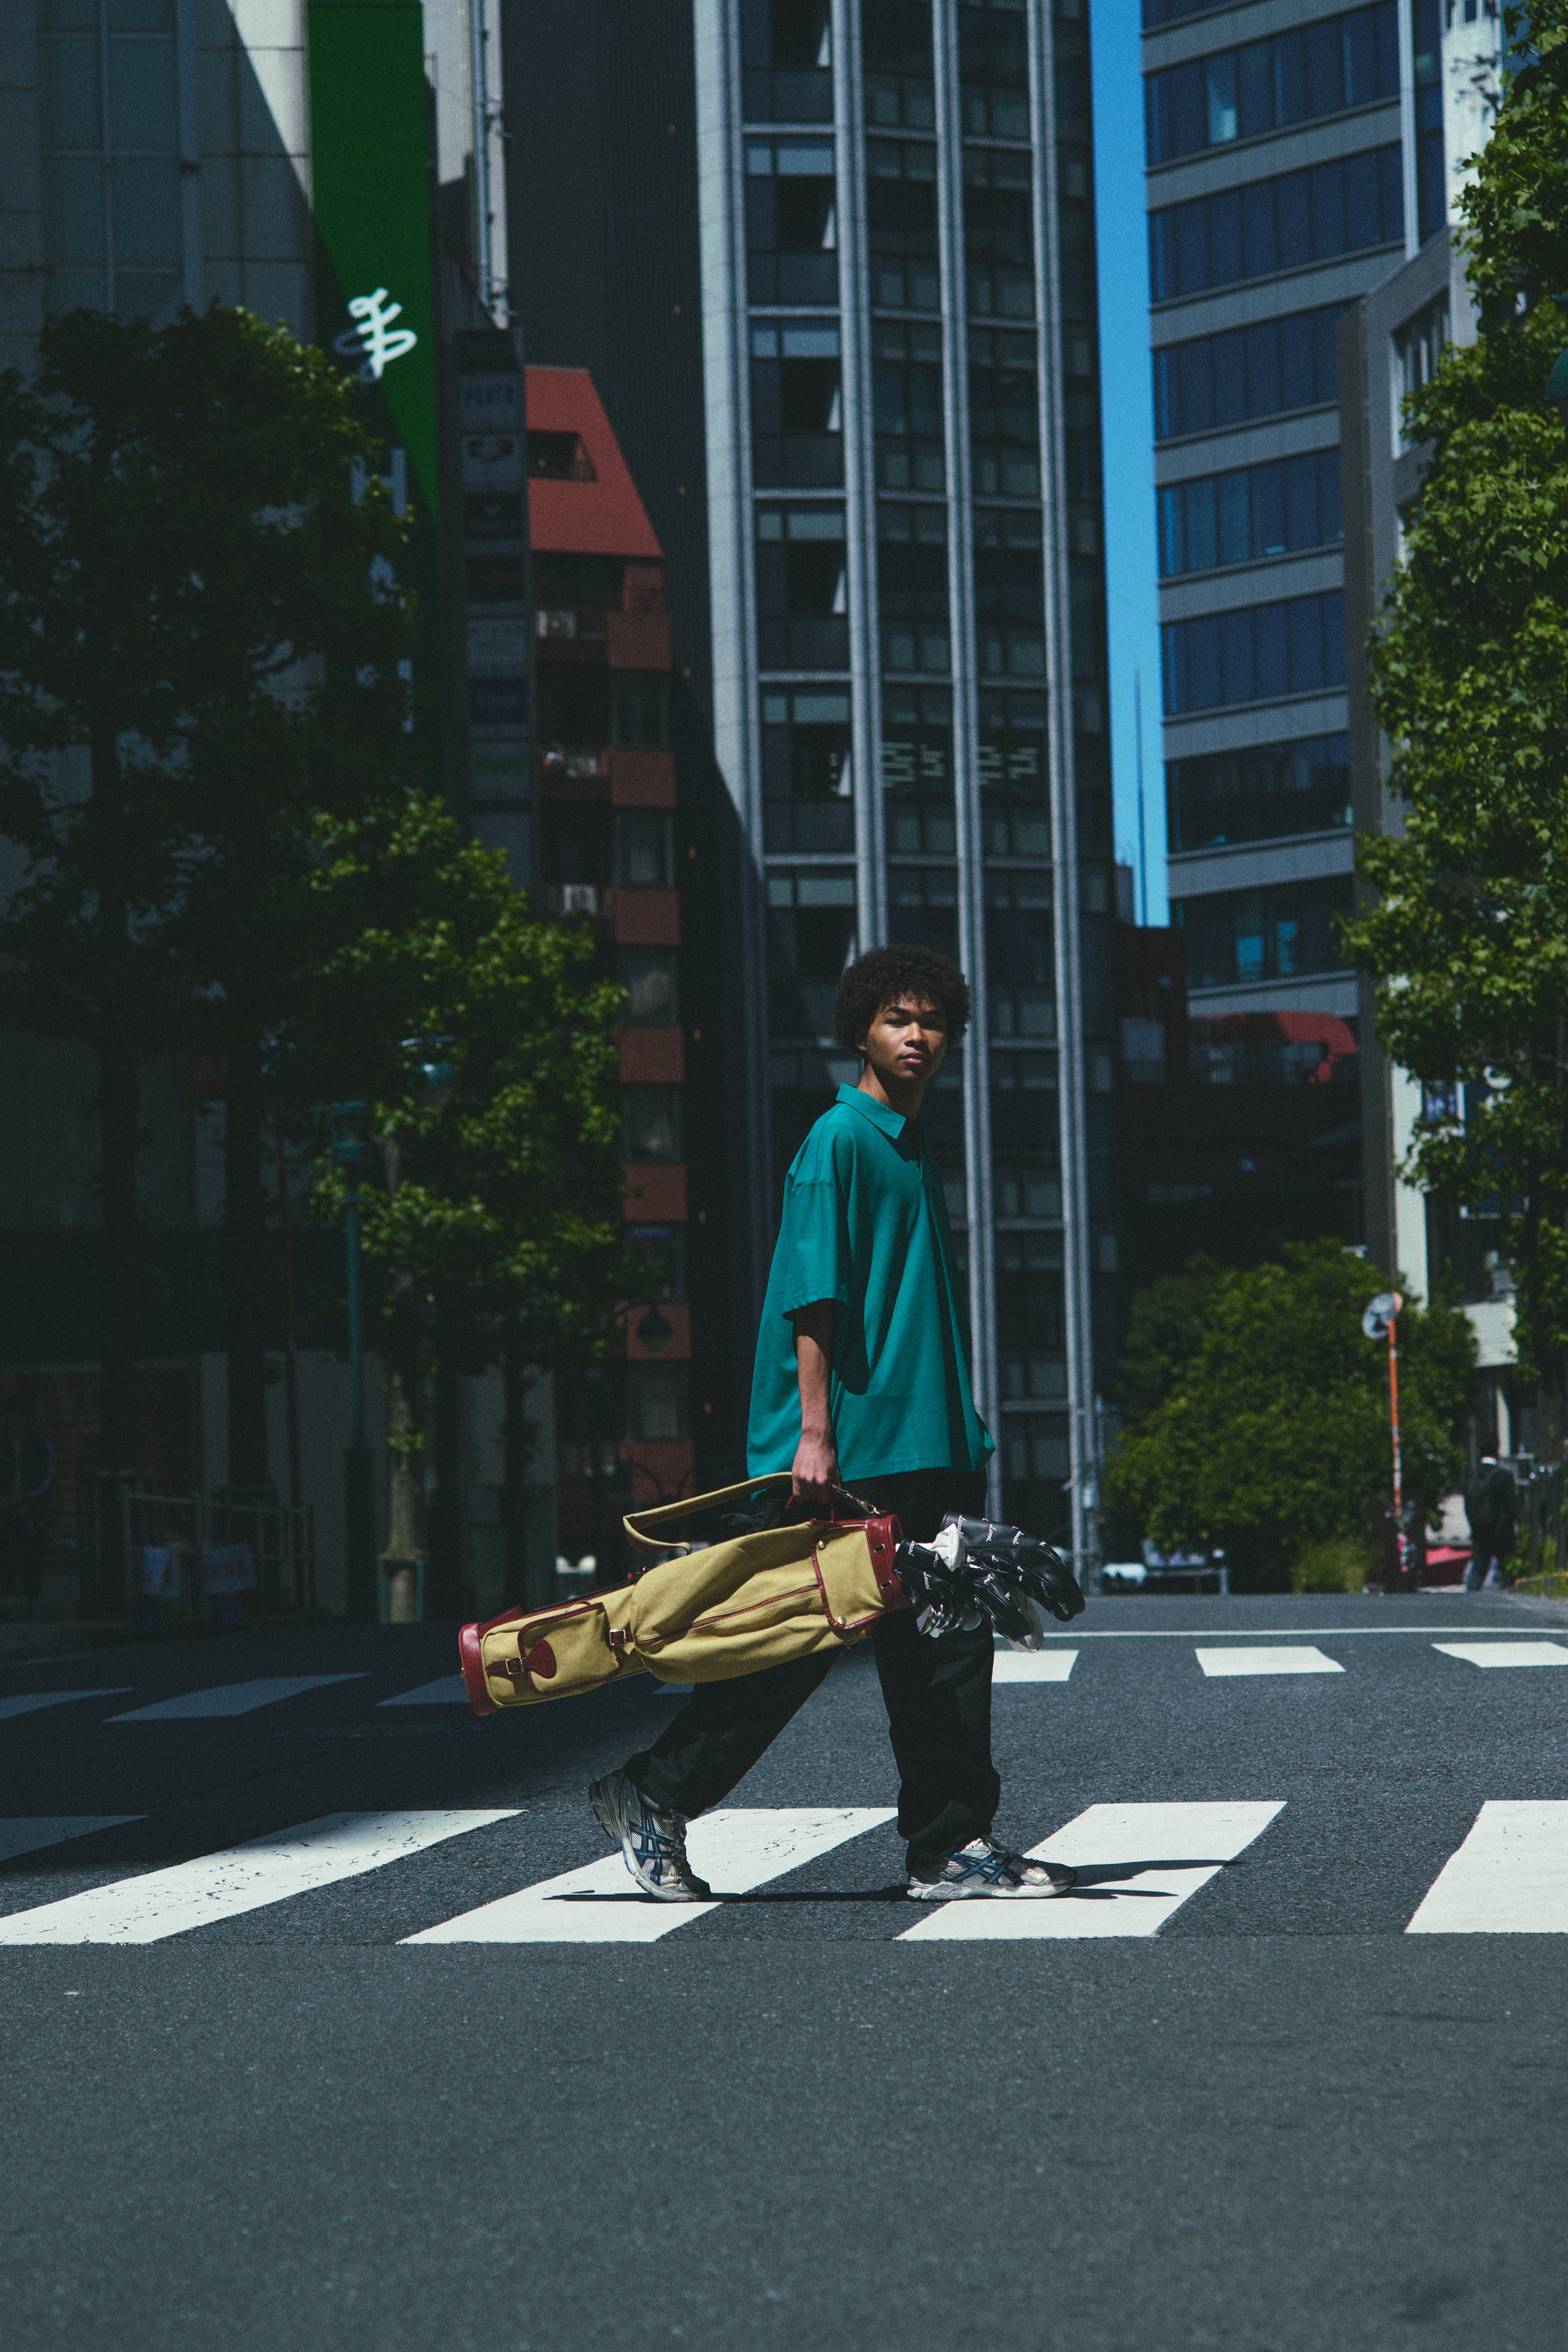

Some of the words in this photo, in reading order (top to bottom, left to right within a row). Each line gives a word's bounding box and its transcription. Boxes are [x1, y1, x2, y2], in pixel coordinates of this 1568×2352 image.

[957, 1514, 966, 1535] Local
[985, 1524, 997, 1542] Local
[908, 1540, 918, 1557] Local
[923, 1571, 932, 1591] Local
